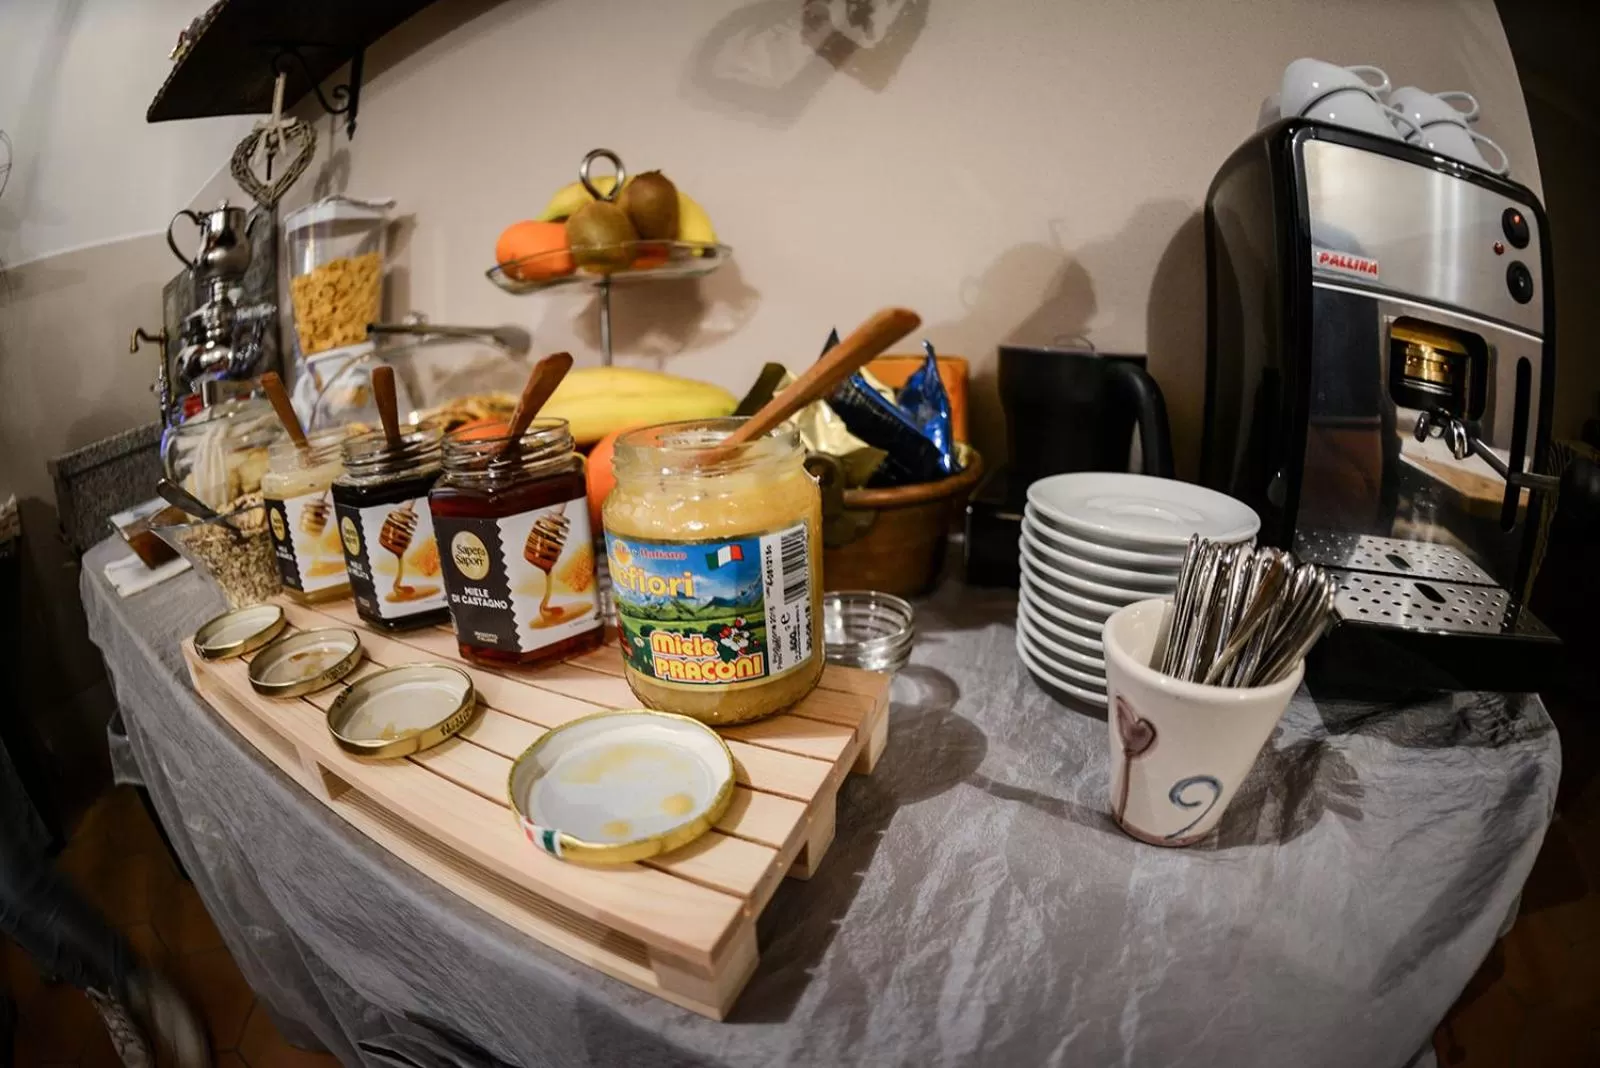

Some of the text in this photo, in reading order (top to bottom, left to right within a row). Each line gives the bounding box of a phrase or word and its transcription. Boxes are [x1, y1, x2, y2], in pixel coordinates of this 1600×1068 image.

[1319, 251, 1377, 275] PALLINA
[461, 595, 508, 610] CASTAGNO
[464, 587, 490, 598] MIELE
[651, 631, 718, 657] Miele
[655, 655, 764, 681] PRACONI
